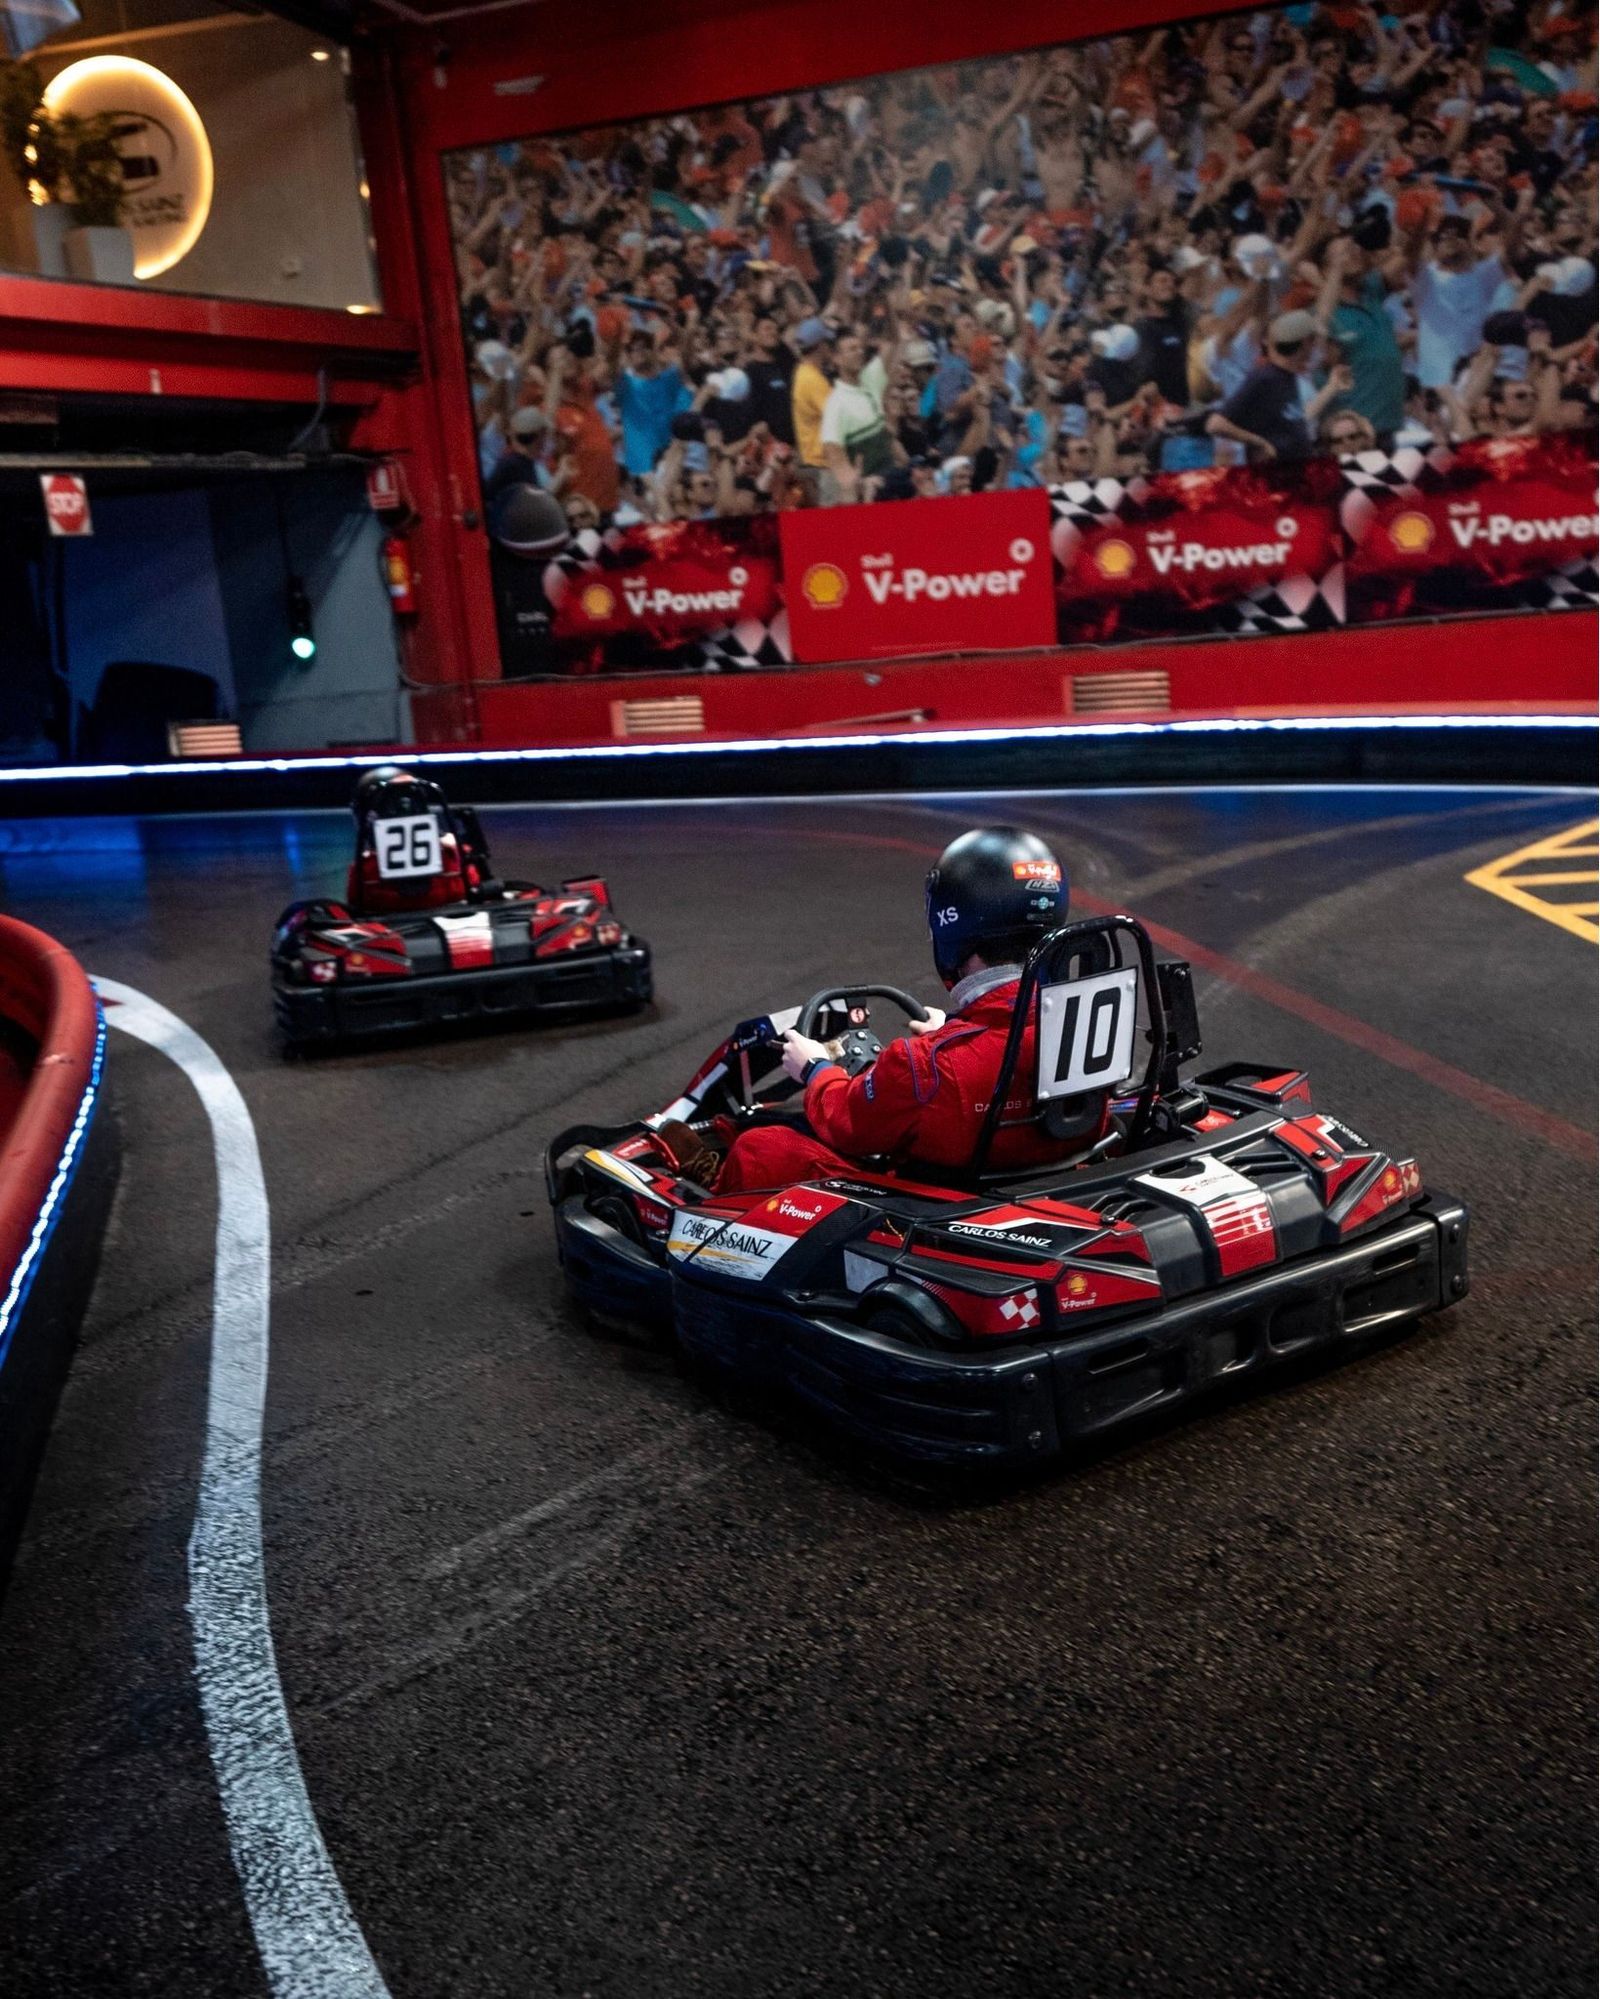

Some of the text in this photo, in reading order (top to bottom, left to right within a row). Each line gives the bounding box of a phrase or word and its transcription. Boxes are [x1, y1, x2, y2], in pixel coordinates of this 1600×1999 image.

[48, 491, 84, 515] STOP
[1147, 542, 1292, 574] V-Power
[862, 569, 1026, 605] V-Power
[624, 589, 743, 615] V-Power
[386, 822, 431, 870] 26
[937, 906, 959, 926] XS
[1054, 986, 1122, 1083] 10
[779, 1204, 816, 1221] V-Power
[727, 1231, 773, 1259] SAINZ
[948, 1225, 1053, 1248] CARLOS SAINZ
